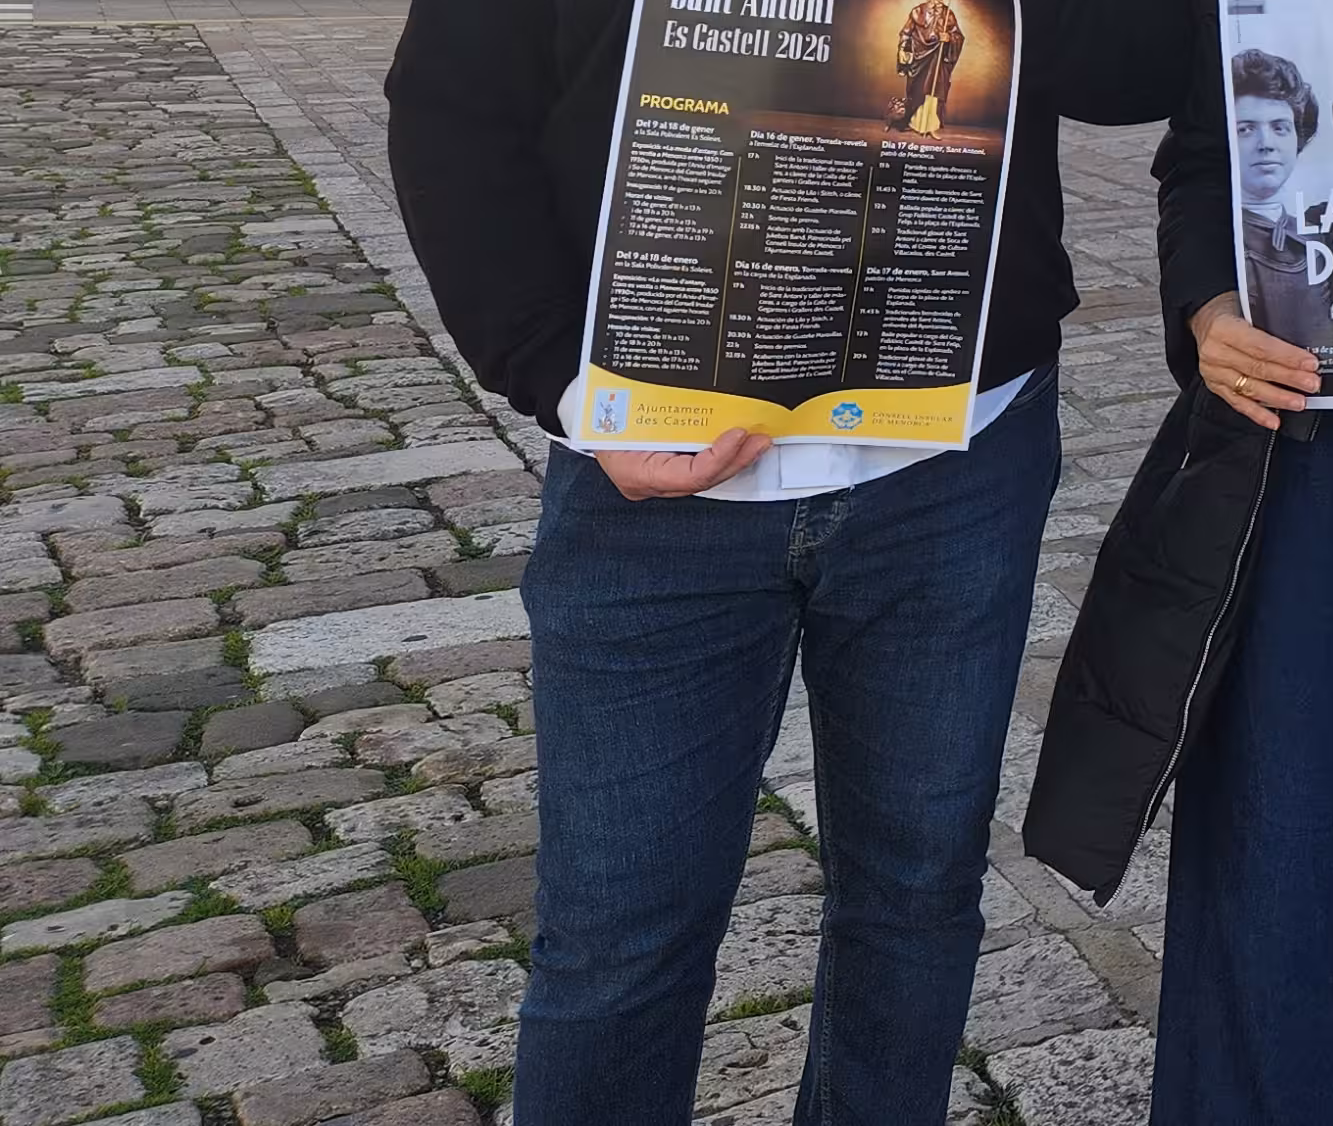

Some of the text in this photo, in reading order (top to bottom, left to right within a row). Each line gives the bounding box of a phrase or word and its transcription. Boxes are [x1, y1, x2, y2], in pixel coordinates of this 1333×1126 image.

[663, 20, 832, 63] Es Castell 2026
[640, 94, 729, 115] PROGRAMA
[636, 119, 651, 128] Del
[652, 120, 658, 128] 9
[668, 122, 678, 130] 18
[680, 123, 690, 131] de
[691, 126, 715, 134] gener
[766, 132, 775, 140] 16
[776, 132, 788, 141] de
[897, 142, 907, 150] 17
[908, 142, 919, 151] de
[616, 251, 631, 259] Del
[640, 253, 648, 261] al
[661, 255, 672, 263] de
[673, 257, 698, 265] enero
[751, 262, 760, 270] 16
[762, 263, 773, 271] de
[882, 267, 891, 275] 17
[638, 404, 714, 415] Ajuntament
[636, 416, 709, 427] des Castell
